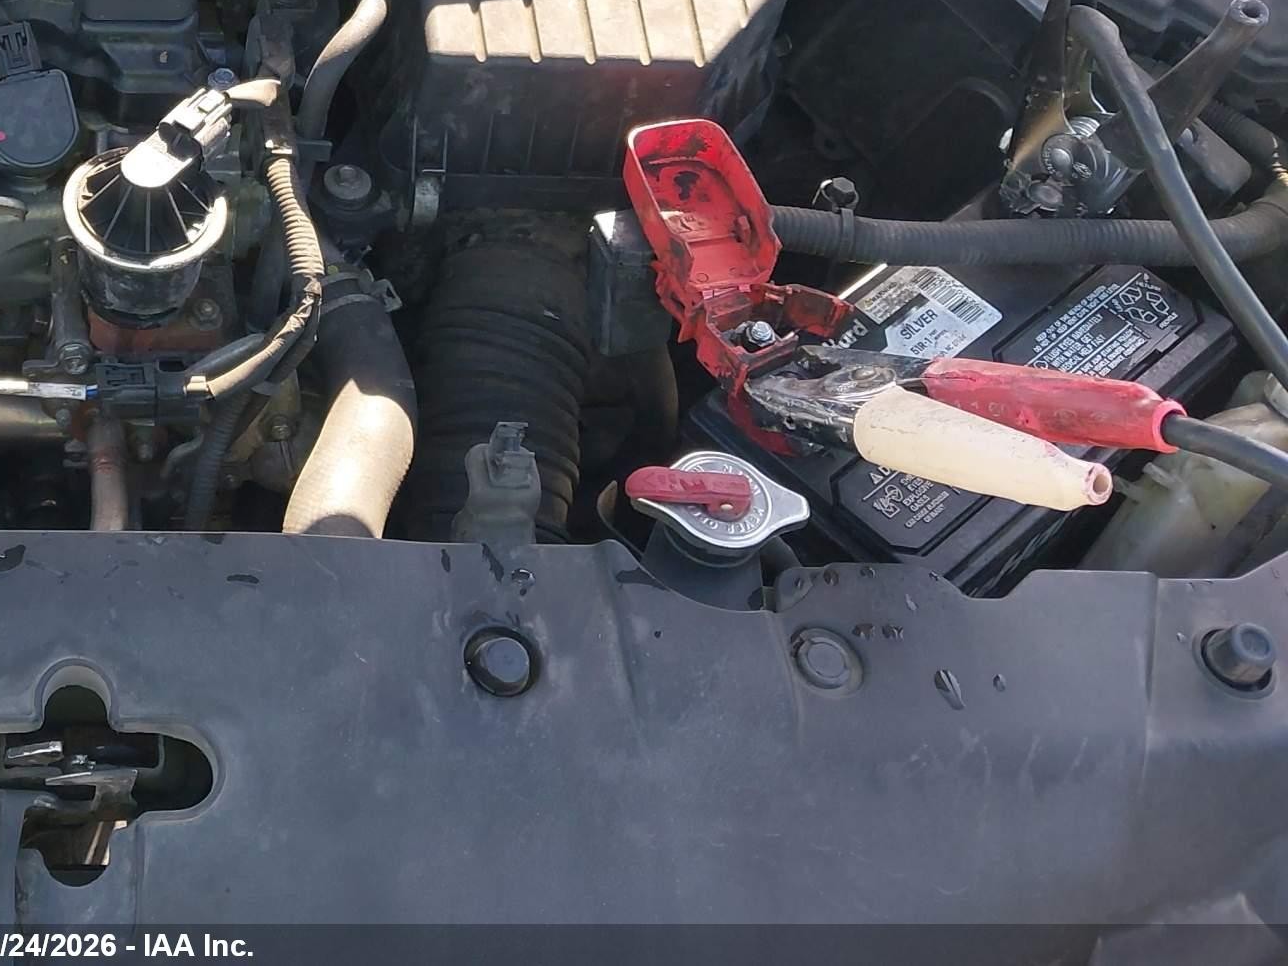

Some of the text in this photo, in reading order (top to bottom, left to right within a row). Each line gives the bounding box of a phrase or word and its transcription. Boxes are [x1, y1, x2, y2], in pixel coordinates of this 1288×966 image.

[900, 309, 939, 340] SILVER
[1043, 347, 1062, 362] FLUSH
[1058, 336, 1075, 349] EYES
